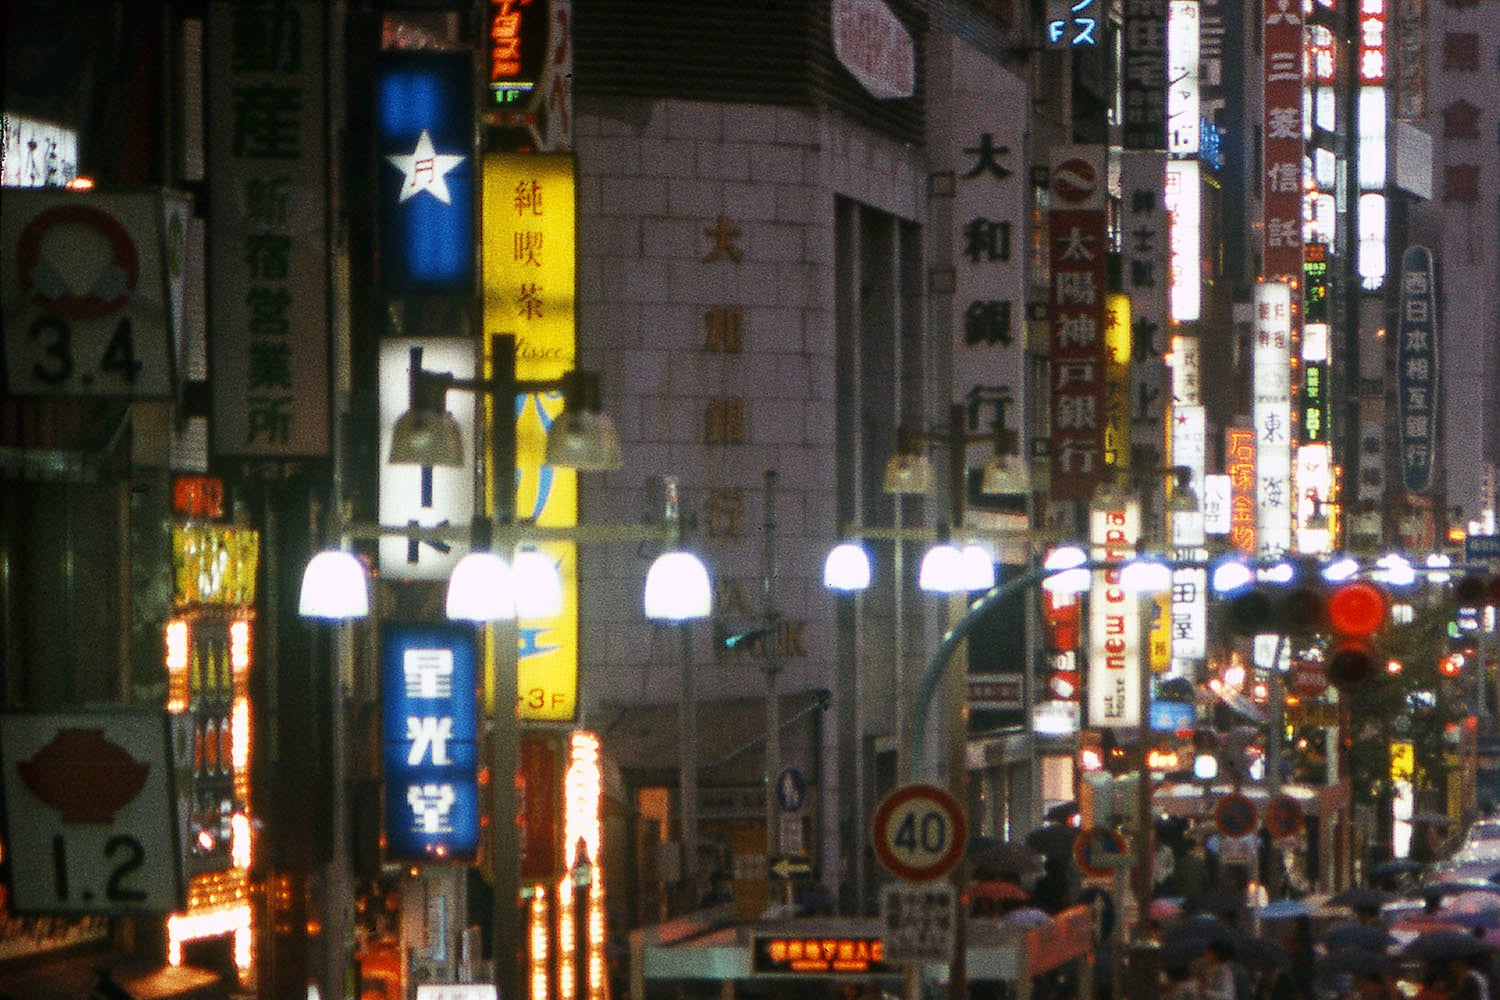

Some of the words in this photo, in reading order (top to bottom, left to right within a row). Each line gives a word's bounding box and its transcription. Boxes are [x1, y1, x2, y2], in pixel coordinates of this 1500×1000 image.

[1267, 53, 1301, 283] 三菱信託
[513, 179, 544, 321] 純喫茶
[961, 133, 1012, 433] 大和銀行
[28, 317, 142, 385] 3.4
[1056, 227, 1099, 474] 太陽神戸銀行
[1104, 616, 1126, 670] new
[403, 648, 455, 833] 星光堂
[894, 811, 945, 855] 40
